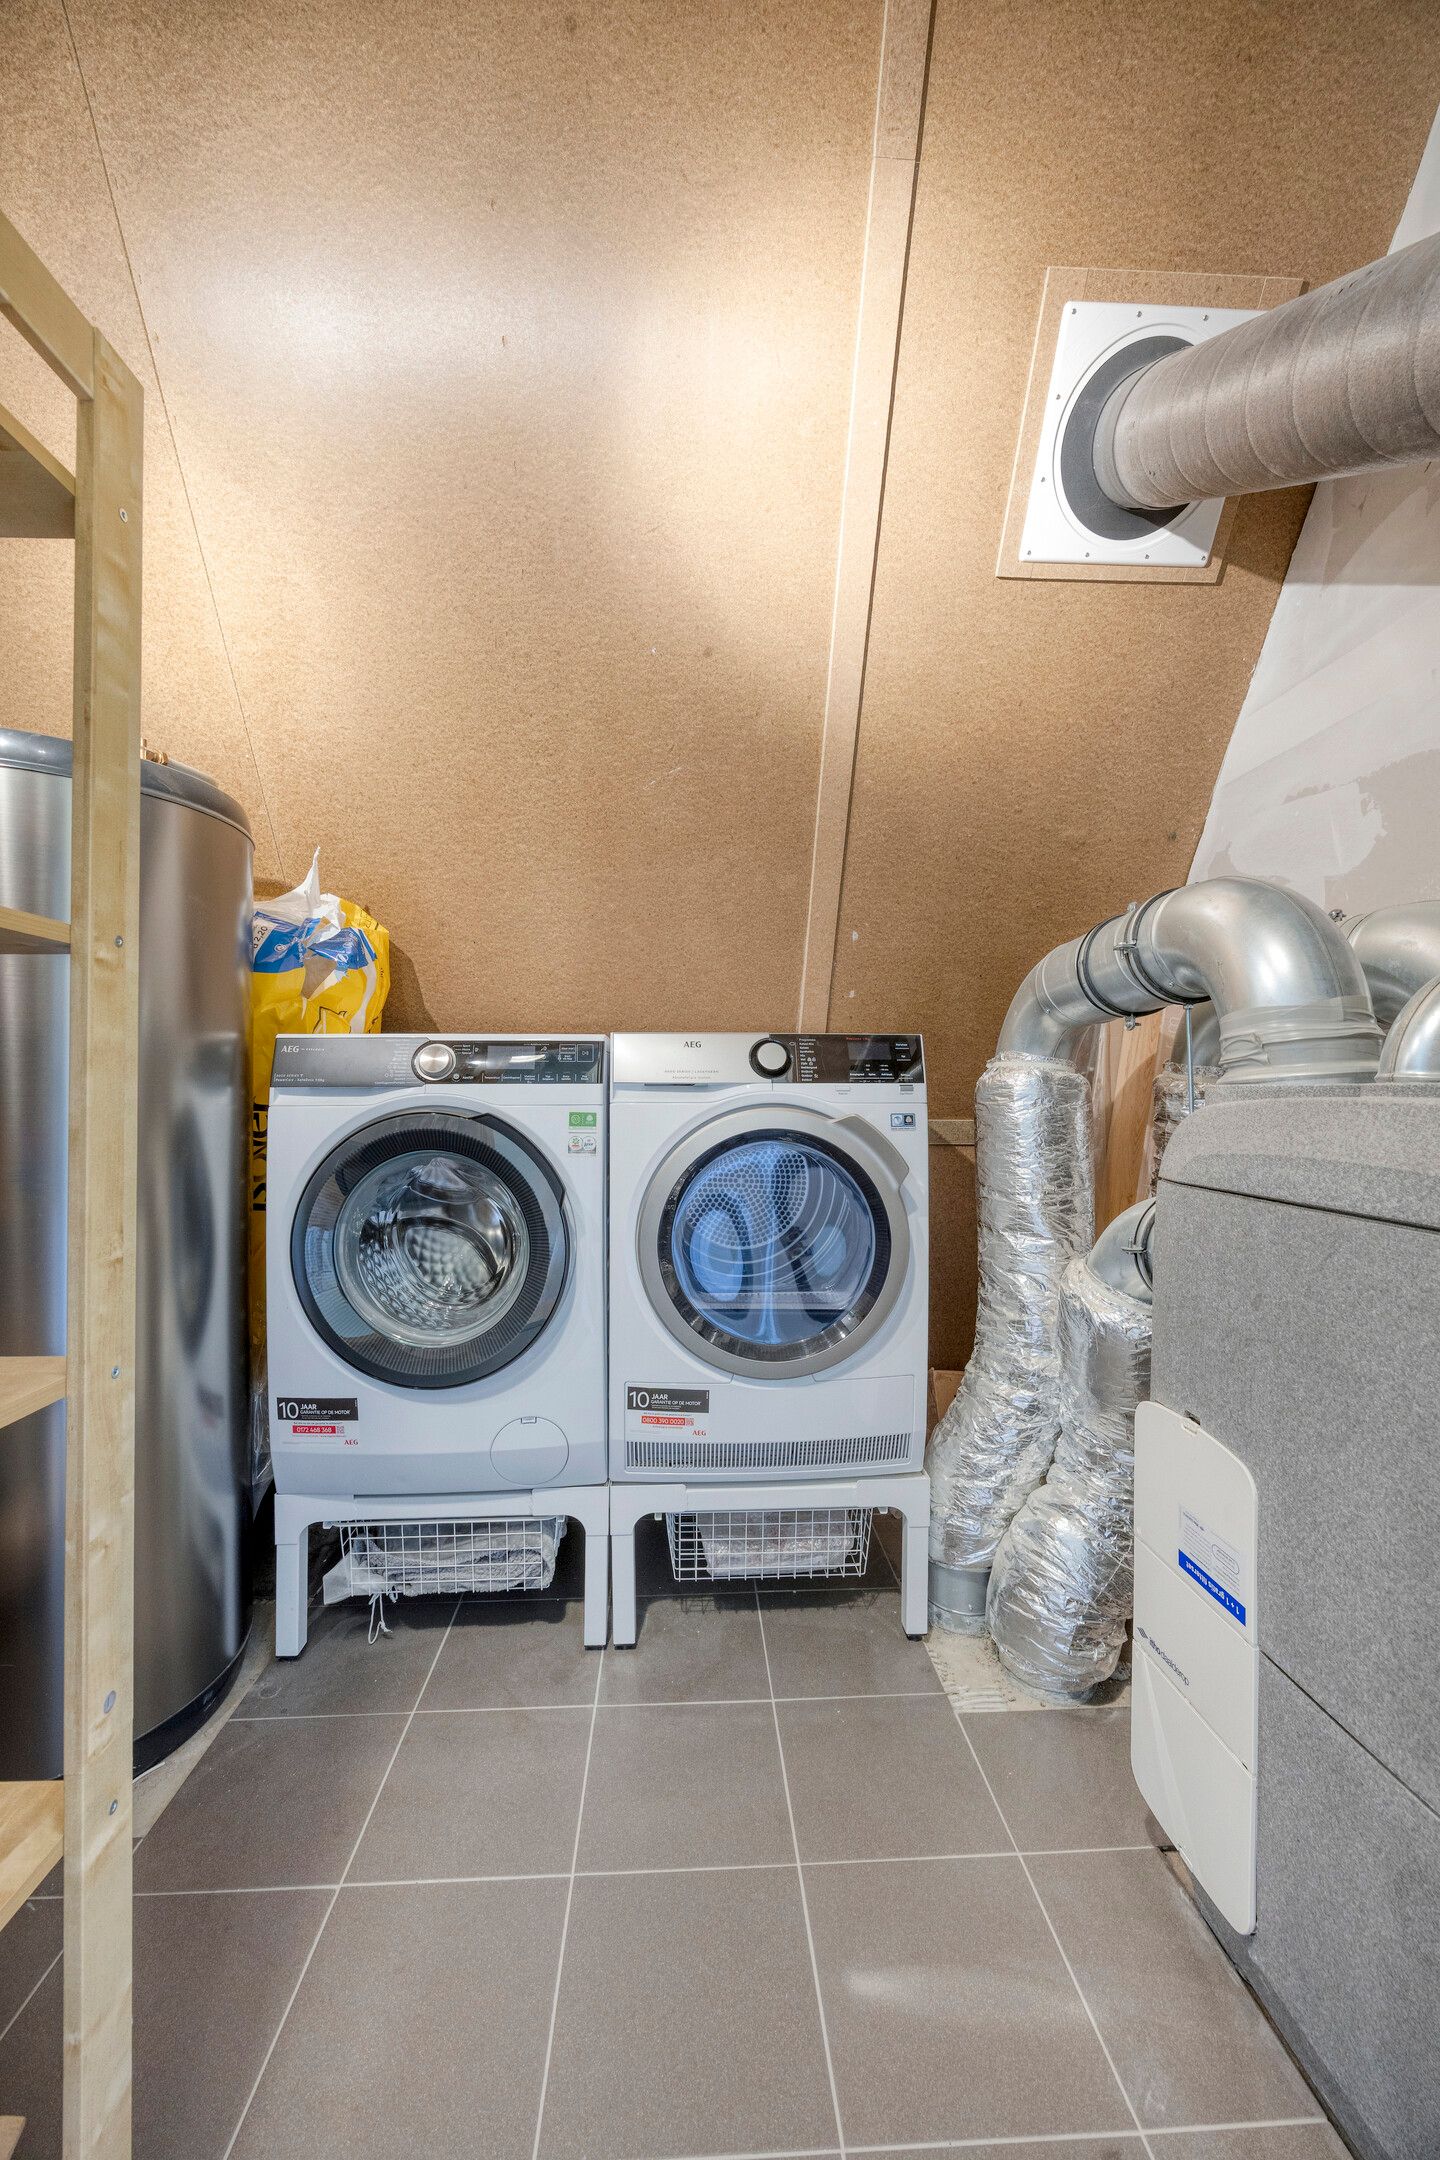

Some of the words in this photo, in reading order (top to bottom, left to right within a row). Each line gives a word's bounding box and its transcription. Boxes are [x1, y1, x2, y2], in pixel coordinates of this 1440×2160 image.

[280, 1045, 300, 1053] AEG
[629, 1391, 650, 1408] 10
[278, 1401, 299, 1419] 10
